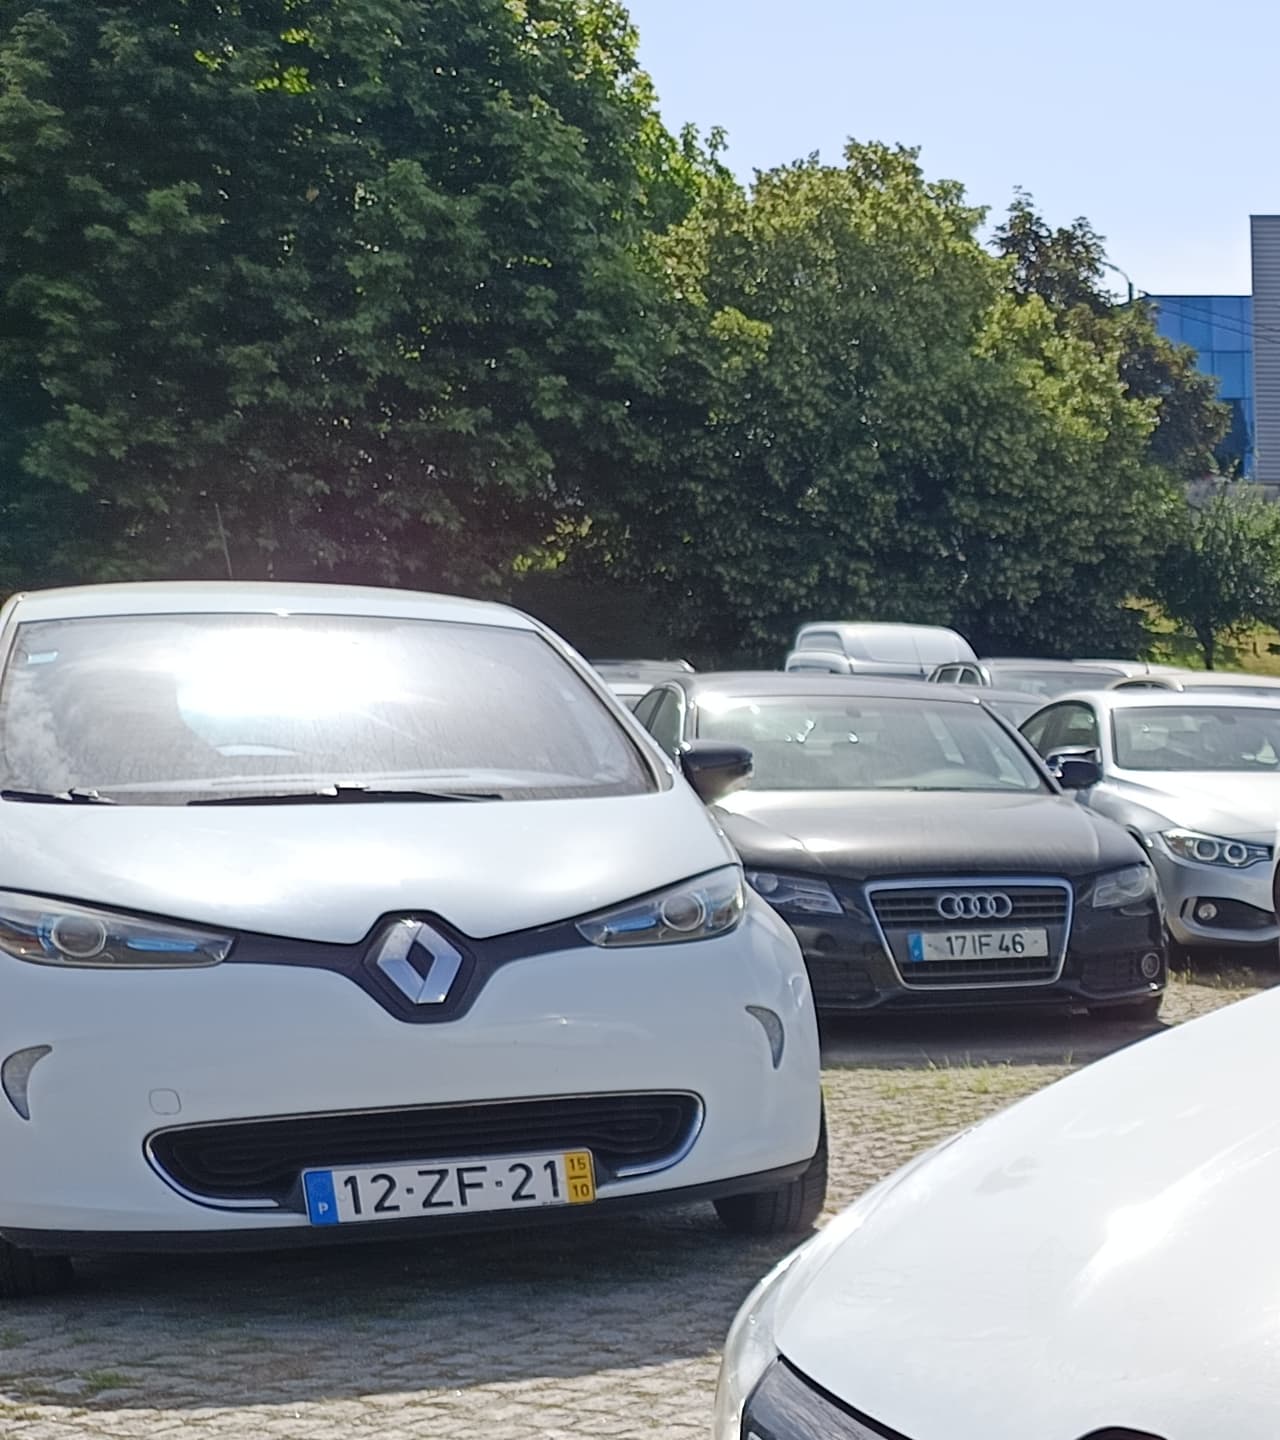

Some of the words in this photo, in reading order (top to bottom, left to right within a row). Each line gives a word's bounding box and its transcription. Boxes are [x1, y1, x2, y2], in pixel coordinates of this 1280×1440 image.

[569, 1158, 587, 1171] 15
[572, 1183, 590, 1198] 10
[318, 1202, 329, 1215] P
